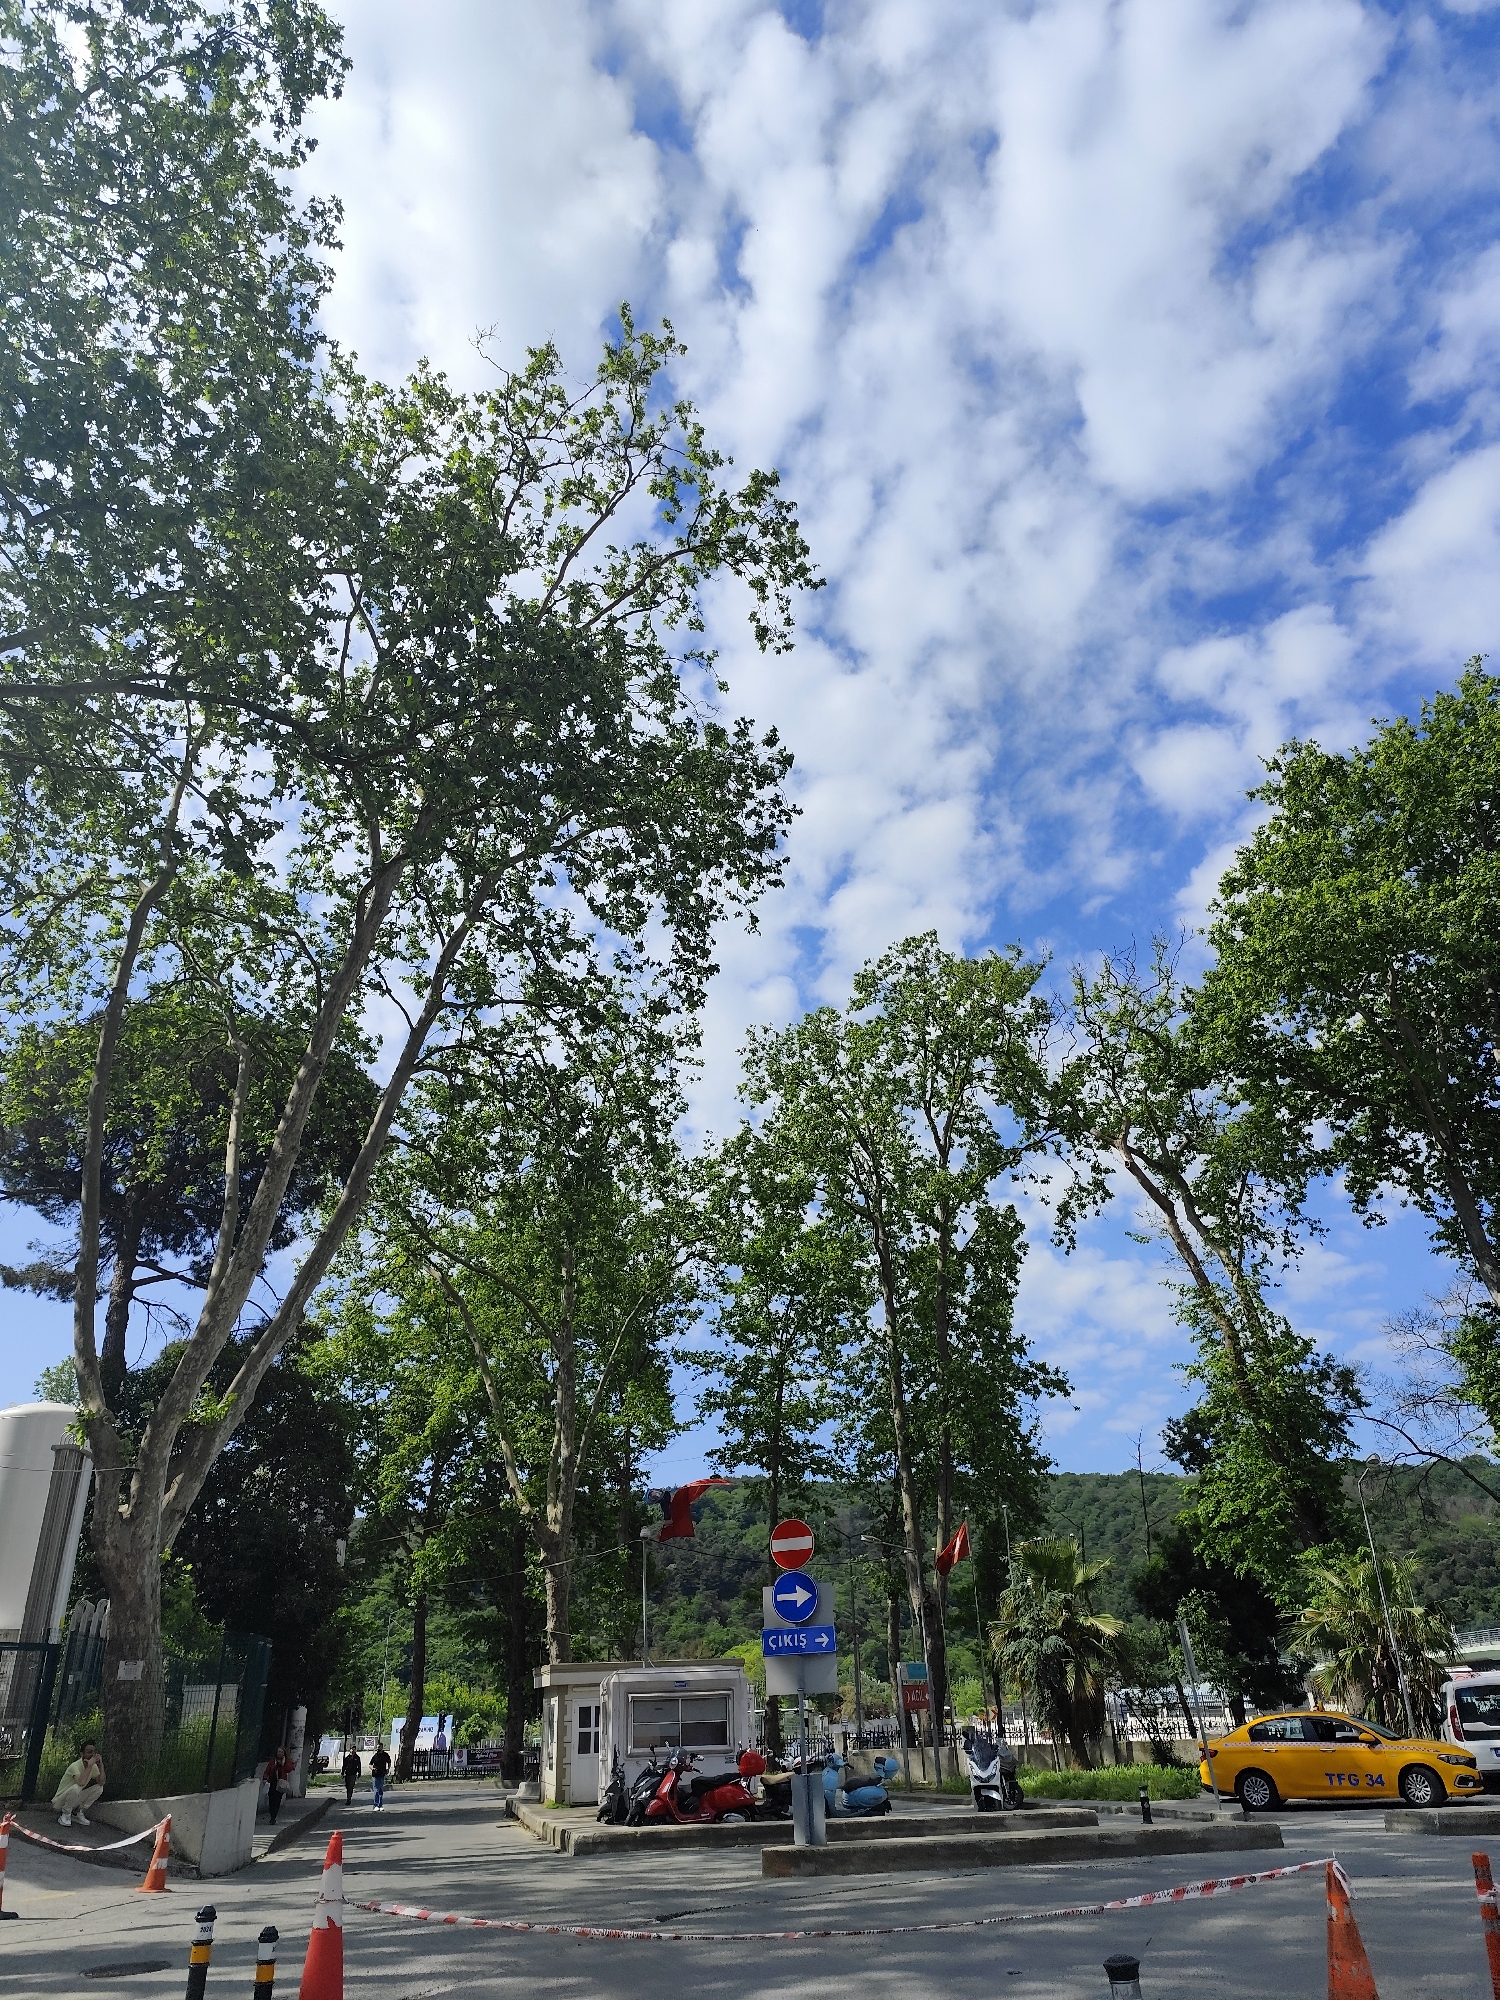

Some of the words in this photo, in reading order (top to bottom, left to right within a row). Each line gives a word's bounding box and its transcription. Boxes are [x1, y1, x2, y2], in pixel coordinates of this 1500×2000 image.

[768, 1633, 807, 1651] ÇIKIŞ
[1324, 1772, 1360, 1787] TFG
[1364, 1773, 1386, 1787] 34
